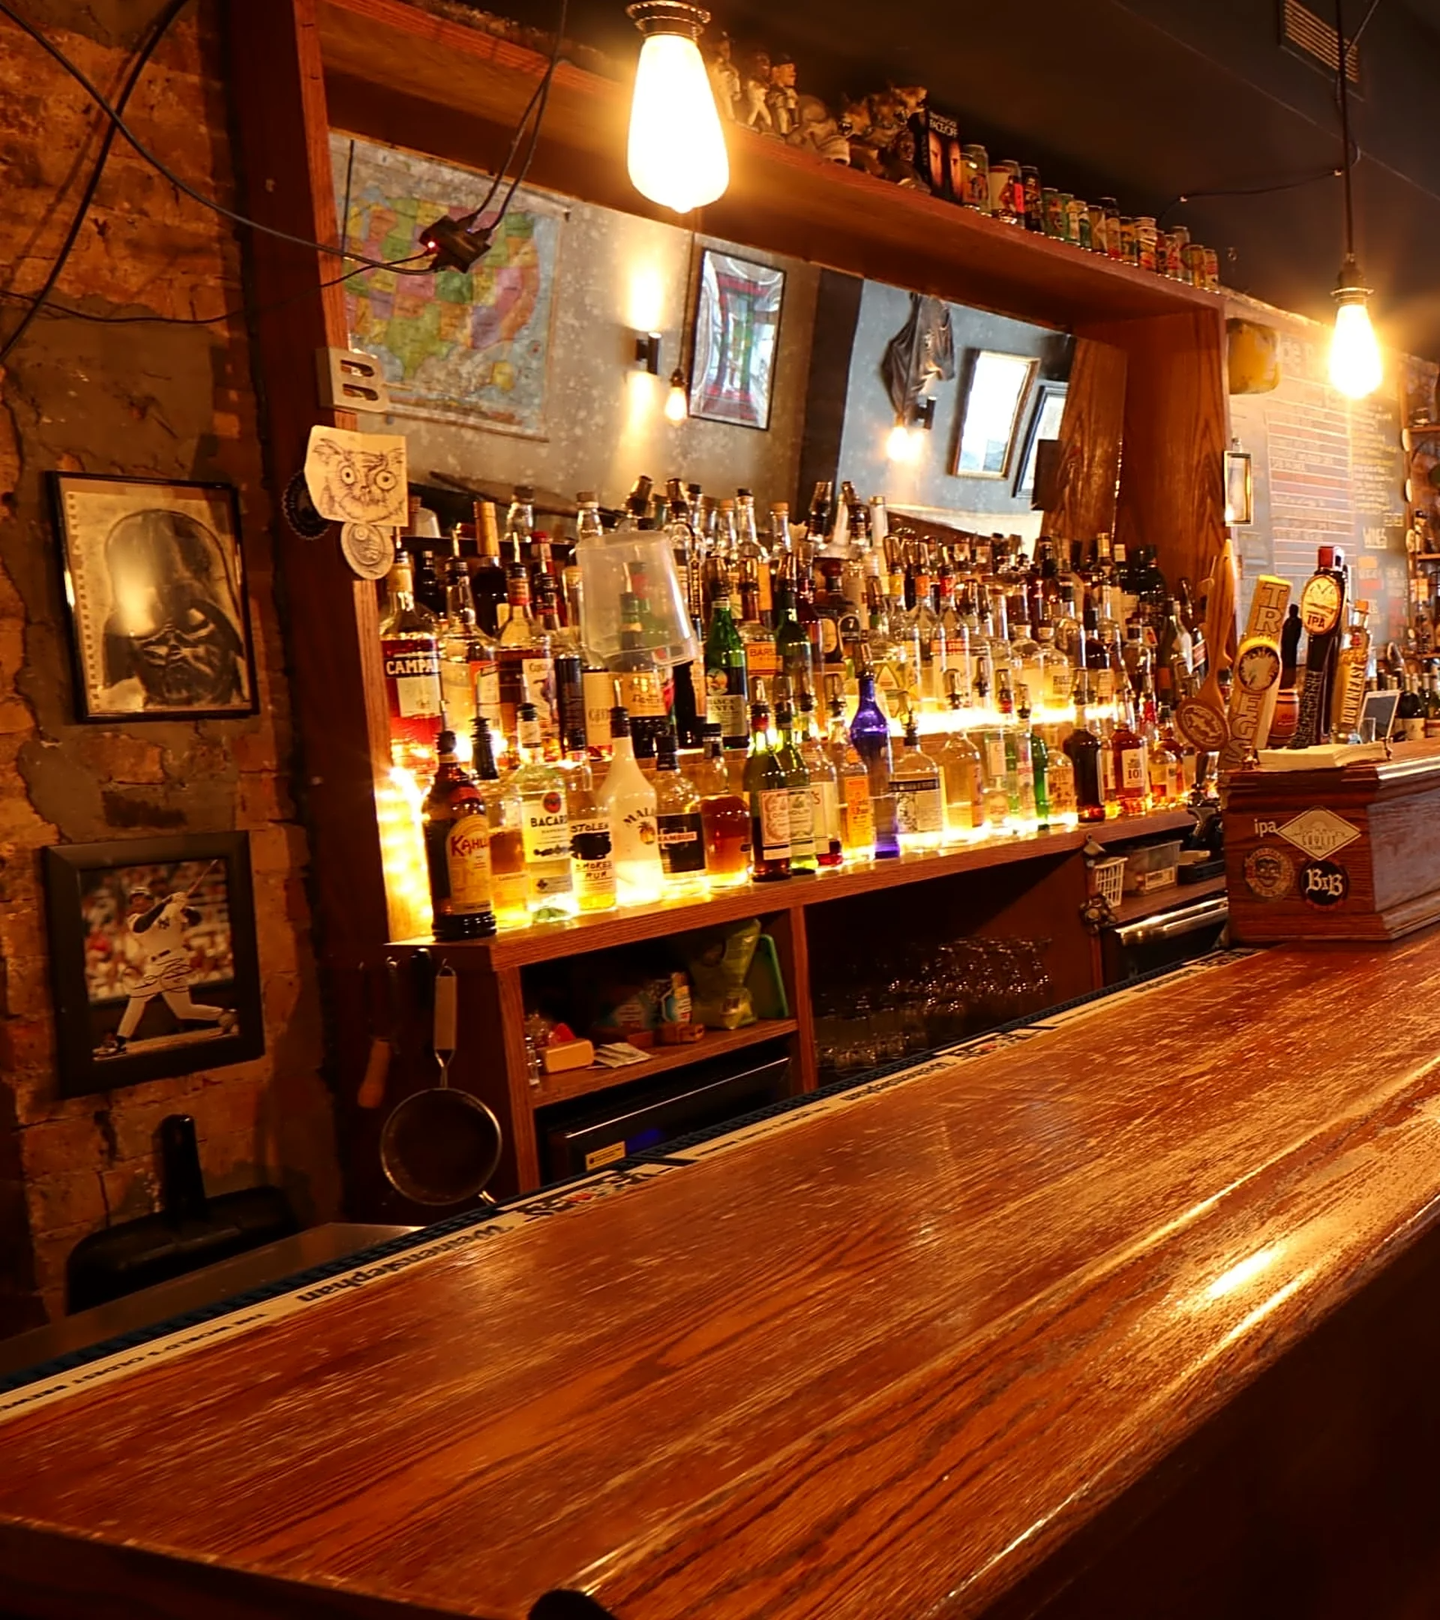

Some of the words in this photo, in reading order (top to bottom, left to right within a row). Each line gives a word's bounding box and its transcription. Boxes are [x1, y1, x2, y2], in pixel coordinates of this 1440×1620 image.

[1307, 615, 1325, 628] IPA
[1340, 662, 1365, 724] DOWNEAST
[1254, 818, 1278, 837] ipa
